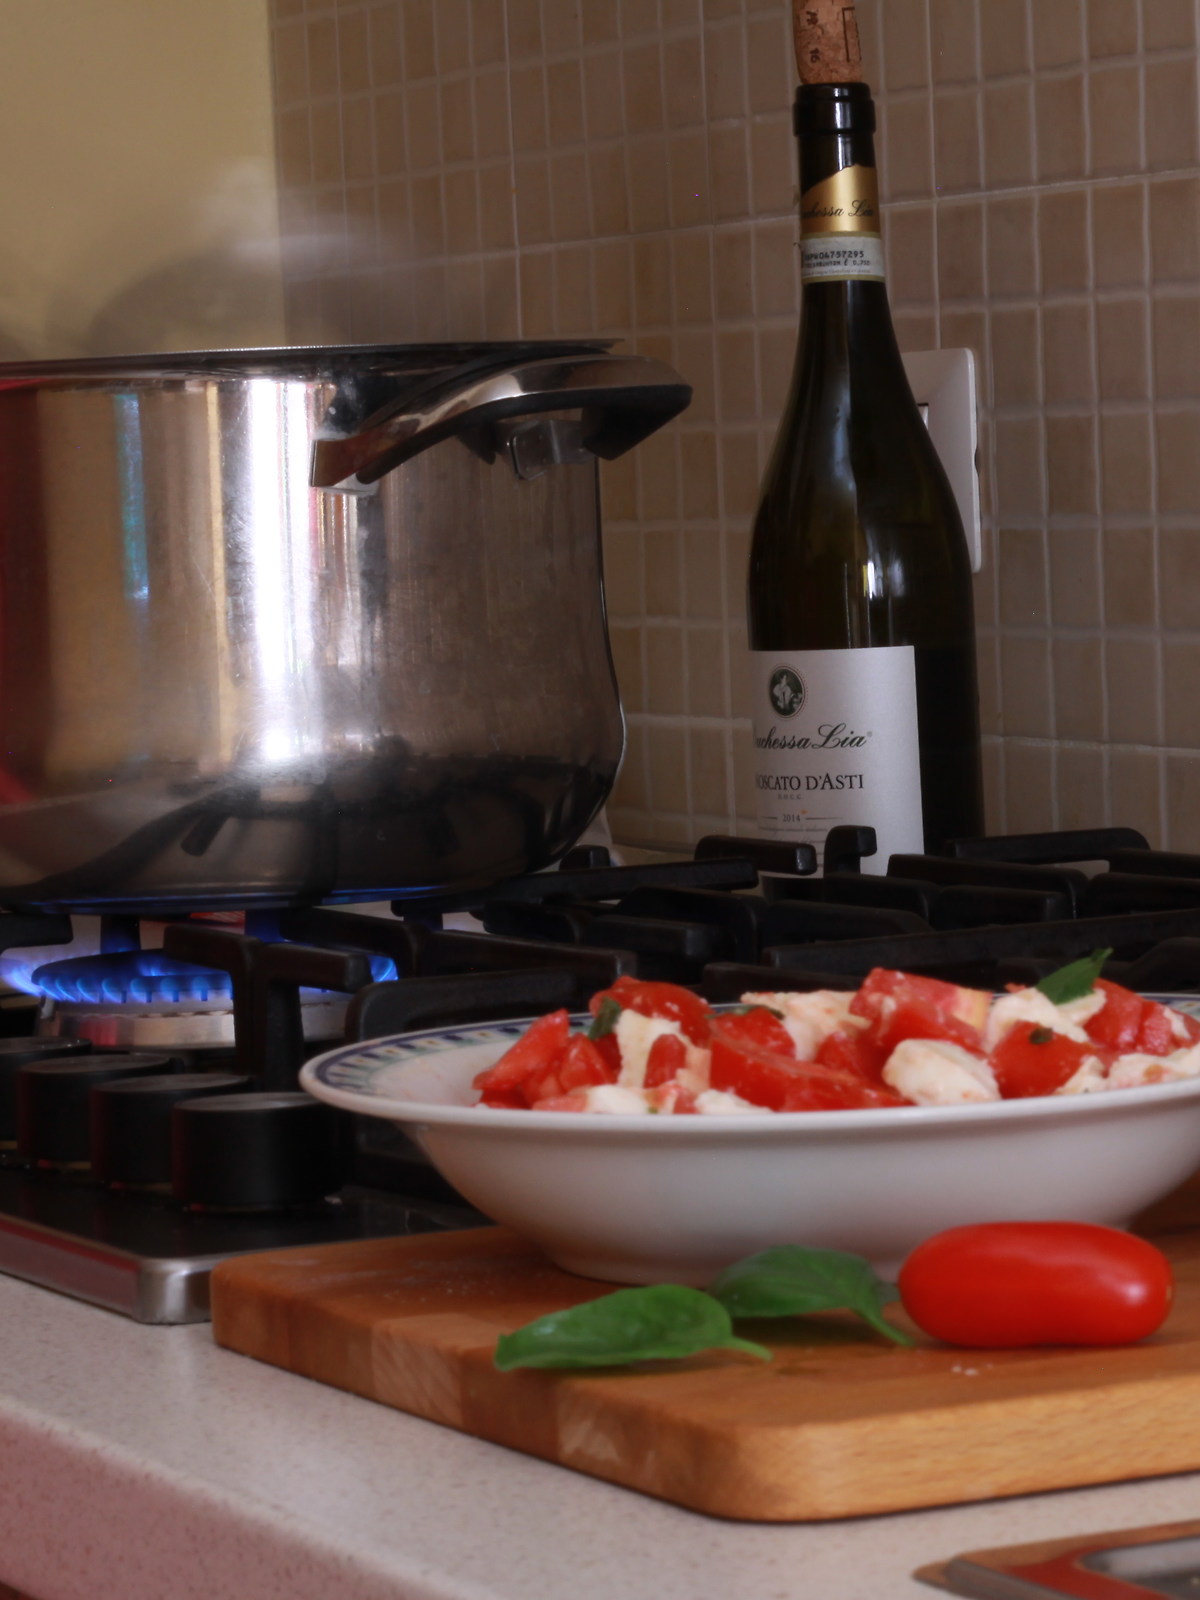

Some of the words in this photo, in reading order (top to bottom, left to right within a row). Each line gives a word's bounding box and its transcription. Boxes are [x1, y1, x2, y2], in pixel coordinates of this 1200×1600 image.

[811, 723, 867, 750] Lia
[805, 772, 865, 791] D'ASTI
[781, 813, 801, 822] 2014
